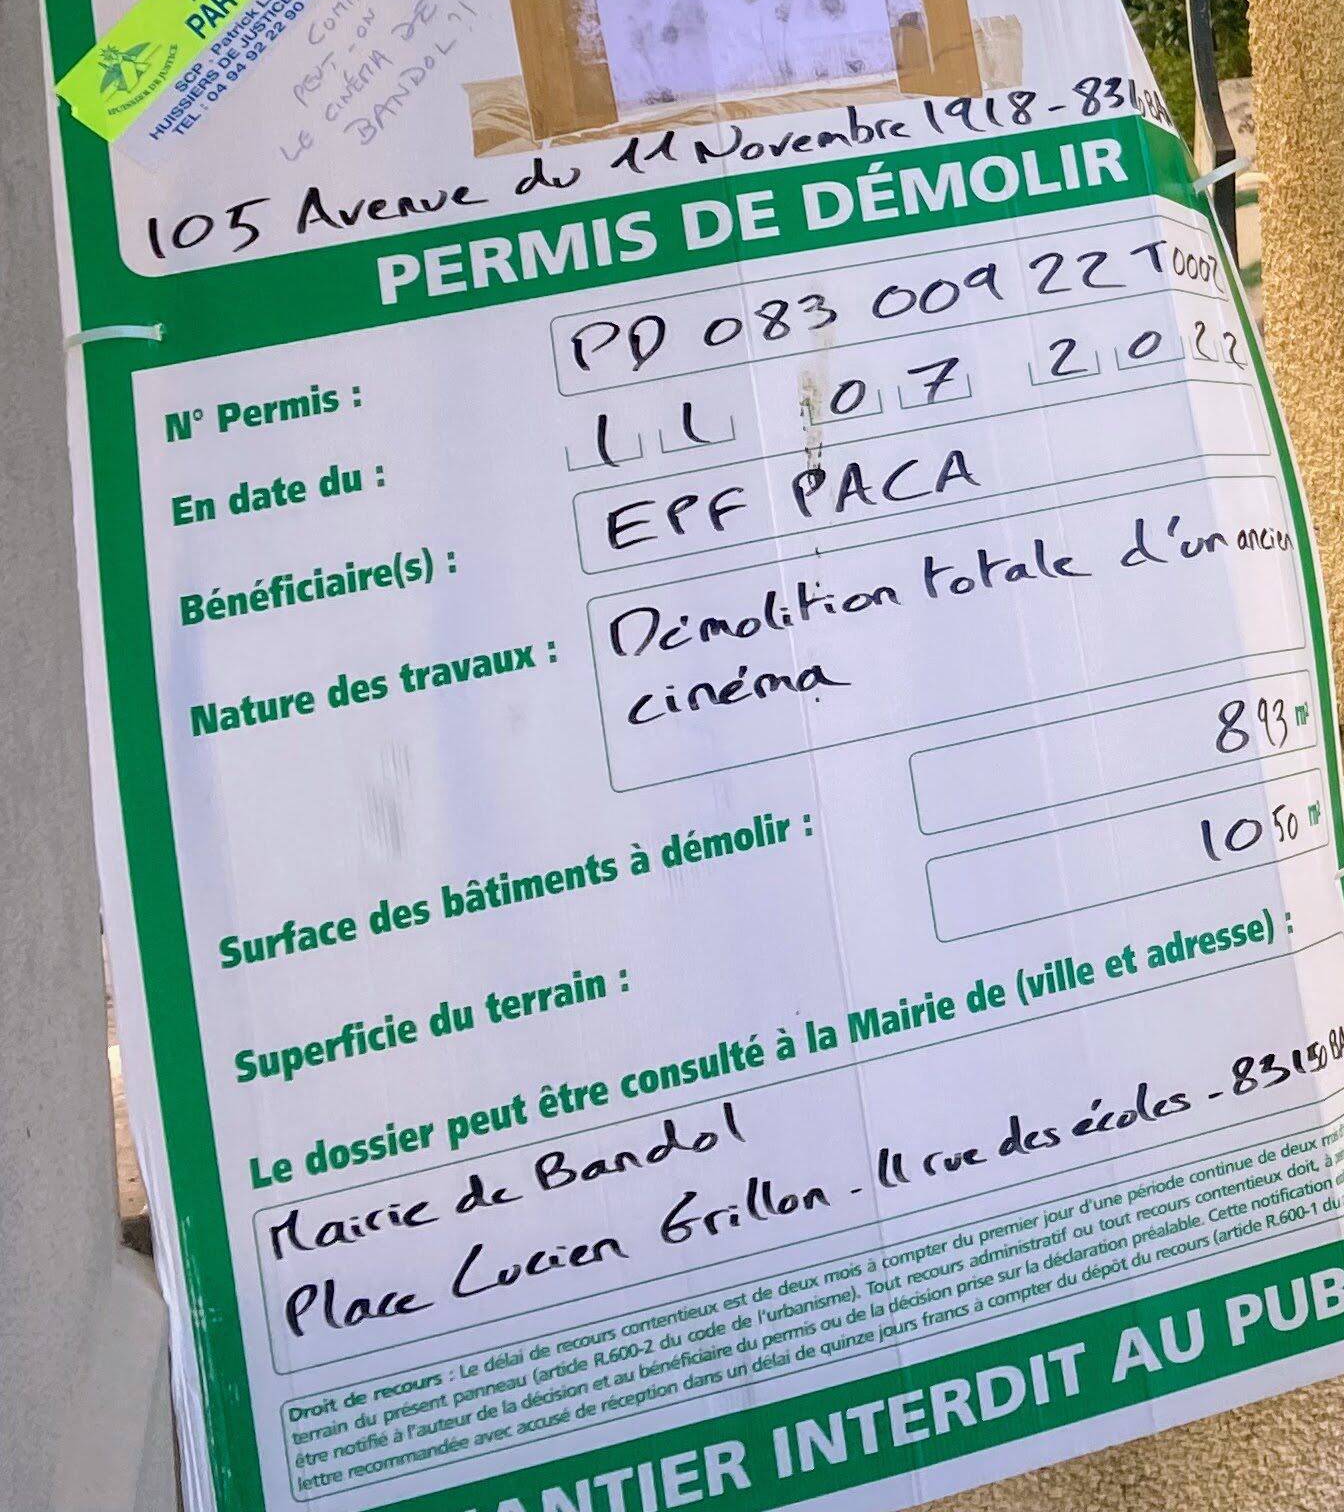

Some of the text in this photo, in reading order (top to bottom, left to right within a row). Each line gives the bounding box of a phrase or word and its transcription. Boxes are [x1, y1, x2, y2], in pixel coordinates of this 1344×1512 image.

[149, 69, 219, 139] HUISSIERS
[217, 47, 240, 69] DE
[171, 113, 201, 135] TEL
[206, 83, 227, 102] 04
[225, 62, 246, 81] 94
[245, 41, 266, 61] 92
[264, 20, 286, 41] 22
[283, 1, 304, 20] 90
[174, 62, 202, 92] SCP
[210, 8, 259, 55] Patrick
[343, 39, 456, 145] BANDOL
[148, 197, 272, 260] 105
[297, 186, 489, 236] Avenue
[514, 157, 582, 196] du
[611, 128, 679, 176] 11
[694, 104, 907, 165] Novembre
[925, 90, 1038, 136] 1918
[377, 137, 1129, 306] PERMIS DE DÉMOLIR
[570, 314, 667, 372] PD
[702, 293, 838, 349] 083
[872, 263, 1005, 322] 009
[1027, 251, 1128, 296] 22
[165, 386, 341, 444] N° Permis
[172, 466, 364, 527] En date du
[607, 449, 983, 552] EPF PACA
[179, 547, 436, 627] Bénéficiaire(s)
[609, 582, 902, 658] Démolition
[924, 538, 1093, 600] totale
[1120, 515, 1230, 568] d'un
[190, 644, 537, 738] Nature des travaux
[628, 664, 851, 727] cinéma
[1215, 697, 1288, 754] 893
[1200, 803, 1299, 862] 1050
[219, 814, 791, 969] Surface des bâtiments à démolir
[234, 971, 607, 1084] Superficie du terrain
[249, 907, 1277, 1189] Le dossier peut être consulté à la Mairie de (ville et adresse)
[271, 1102, 748, 1260] Mairie de Bandol
[286, 1282, 436, 1338] Place
[450, 1236, 630, 1300] Lucien
[660, 1175, 832, 1246] Grillon
[922, 1144, 988, 1180] rue
[998, 1114, 1063, 1159] des
[1071, 1081, 1193, 1141] écoles
[1231, 1040, 1328, 1096] 83150
[866, 1277, 902, 1296] Tout
[907, 1259, 964, 1286] recours
[969, 1227, 1069, 1269] administratif
[1073, 1224, 1094, 1239] ou
[1099, 1213, 1132, 1232] tout
[1136, 1198, 1191, 1221] recours
[1195, 1171, 1283, 1205] contentieux
[1324, 1155, 1334, 1169] à
[1208, 1199, 1254, 1224] Cette
[1251, 1178, 1334, 1212] notification
[287, 1400, 338, 1424] Droit
[343, 1393, 368, 1410] de
[373, 1373, 443, 1403] recours
[459, 1364, 480, 1379] Le
[484, 1349, 525, 1374] délai
[529, 1344, 551, 1362] de
[557, 1329, 617, 1353] recours
[621, 1302, 720, 1337] contentieux
[723, 1291, 749, 1311] est
[752, 1286, 773, 1304] de
[777, 1276, 820, 1297] deux
[824, 1263, 863, 1284] mois
[867, 1258, 878, 1273] à
[882, 1240, 949, 1270] compter
[953, 1233, 975, 1250] du
[979, 1213, 1040, 1245] premier
[1043, 1205, 1075, 1229] jour
[1079, 1195, 1123, 1216] d'une
[1127, 1176, 1186, 1204] période
[1189, 1157, 1253, 1184] continue
[1257, 1150, 1277, 1166] de
[1281, 1139, 1318, 1159] deux
[773, 1343, 1086, 1479] INTERDIT
[1110, 1308, 1206, 1383] AU
